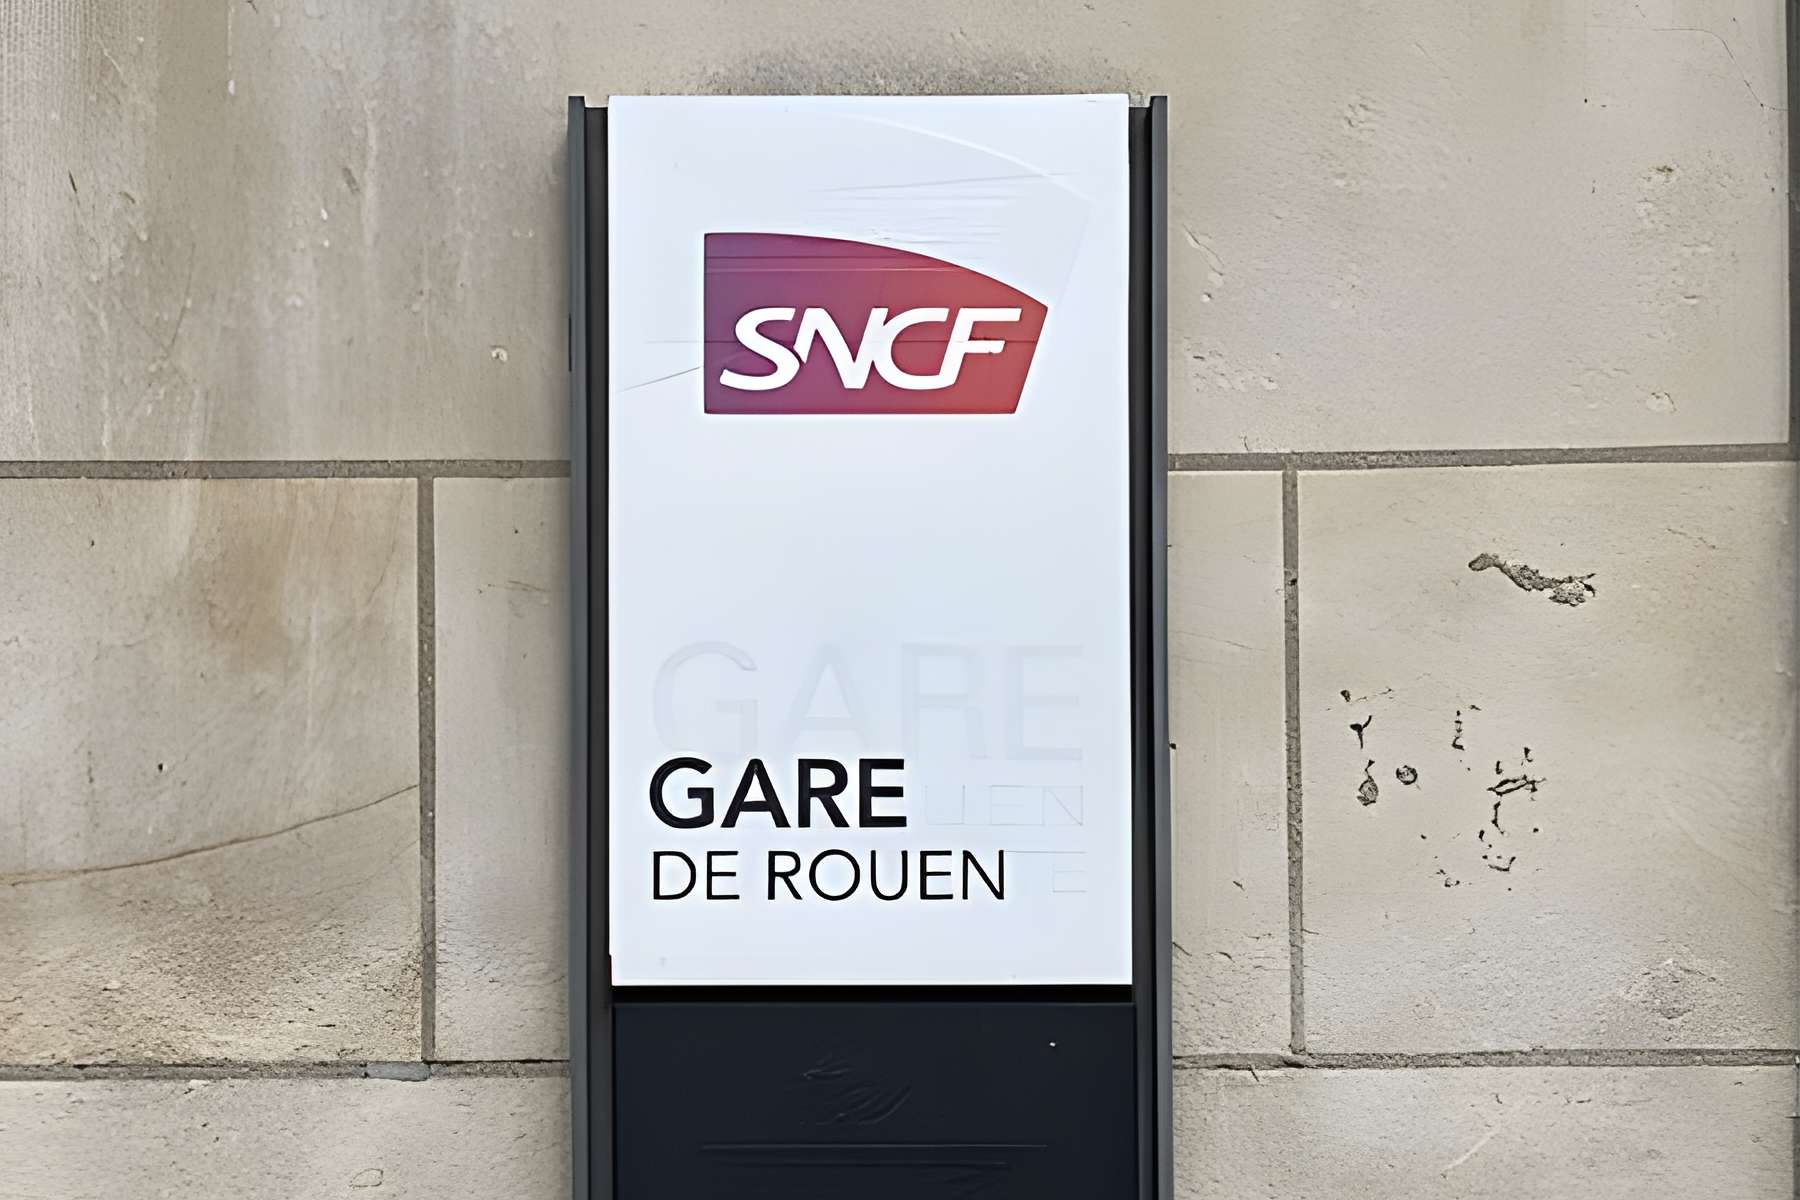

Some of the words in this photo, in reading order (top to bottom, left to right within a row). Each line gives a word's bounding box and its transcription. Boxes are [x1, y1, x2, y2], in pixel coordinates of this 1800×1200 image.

[719, 306, 1022, 391] SNCF
[649, 757, 908, 829] GARE
[653, 850, 740, 900] DE
[767, 849, 1005, 902] ROUEN
